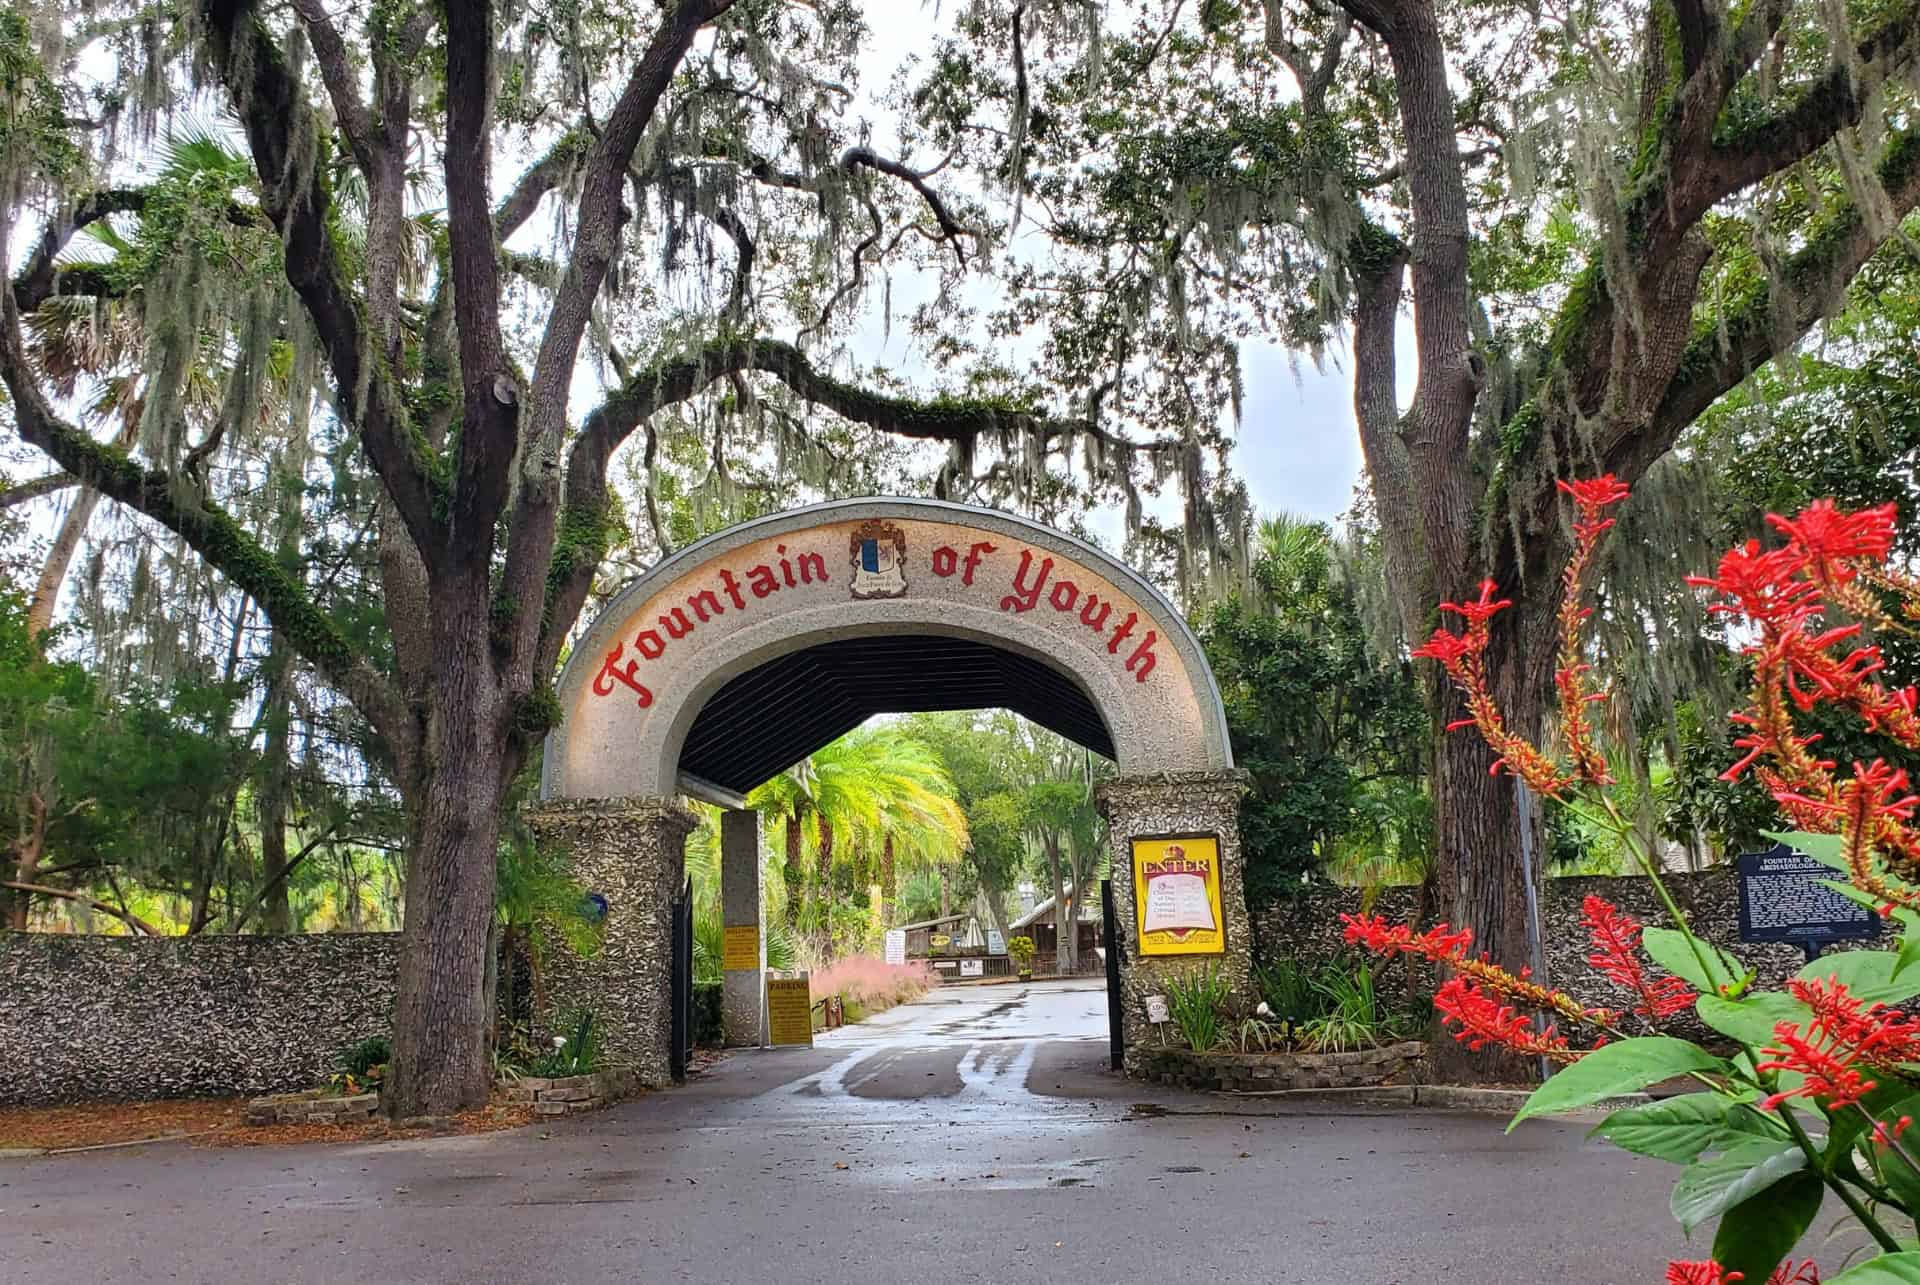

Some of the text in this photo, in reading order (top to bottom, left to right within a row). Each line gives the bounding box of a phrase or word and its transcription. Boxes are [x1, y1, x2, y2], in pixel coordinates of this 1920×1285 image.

[592, 542, 1157, 709] Fountain of Youth
[1142, 859, 1209, 874] ENTER
